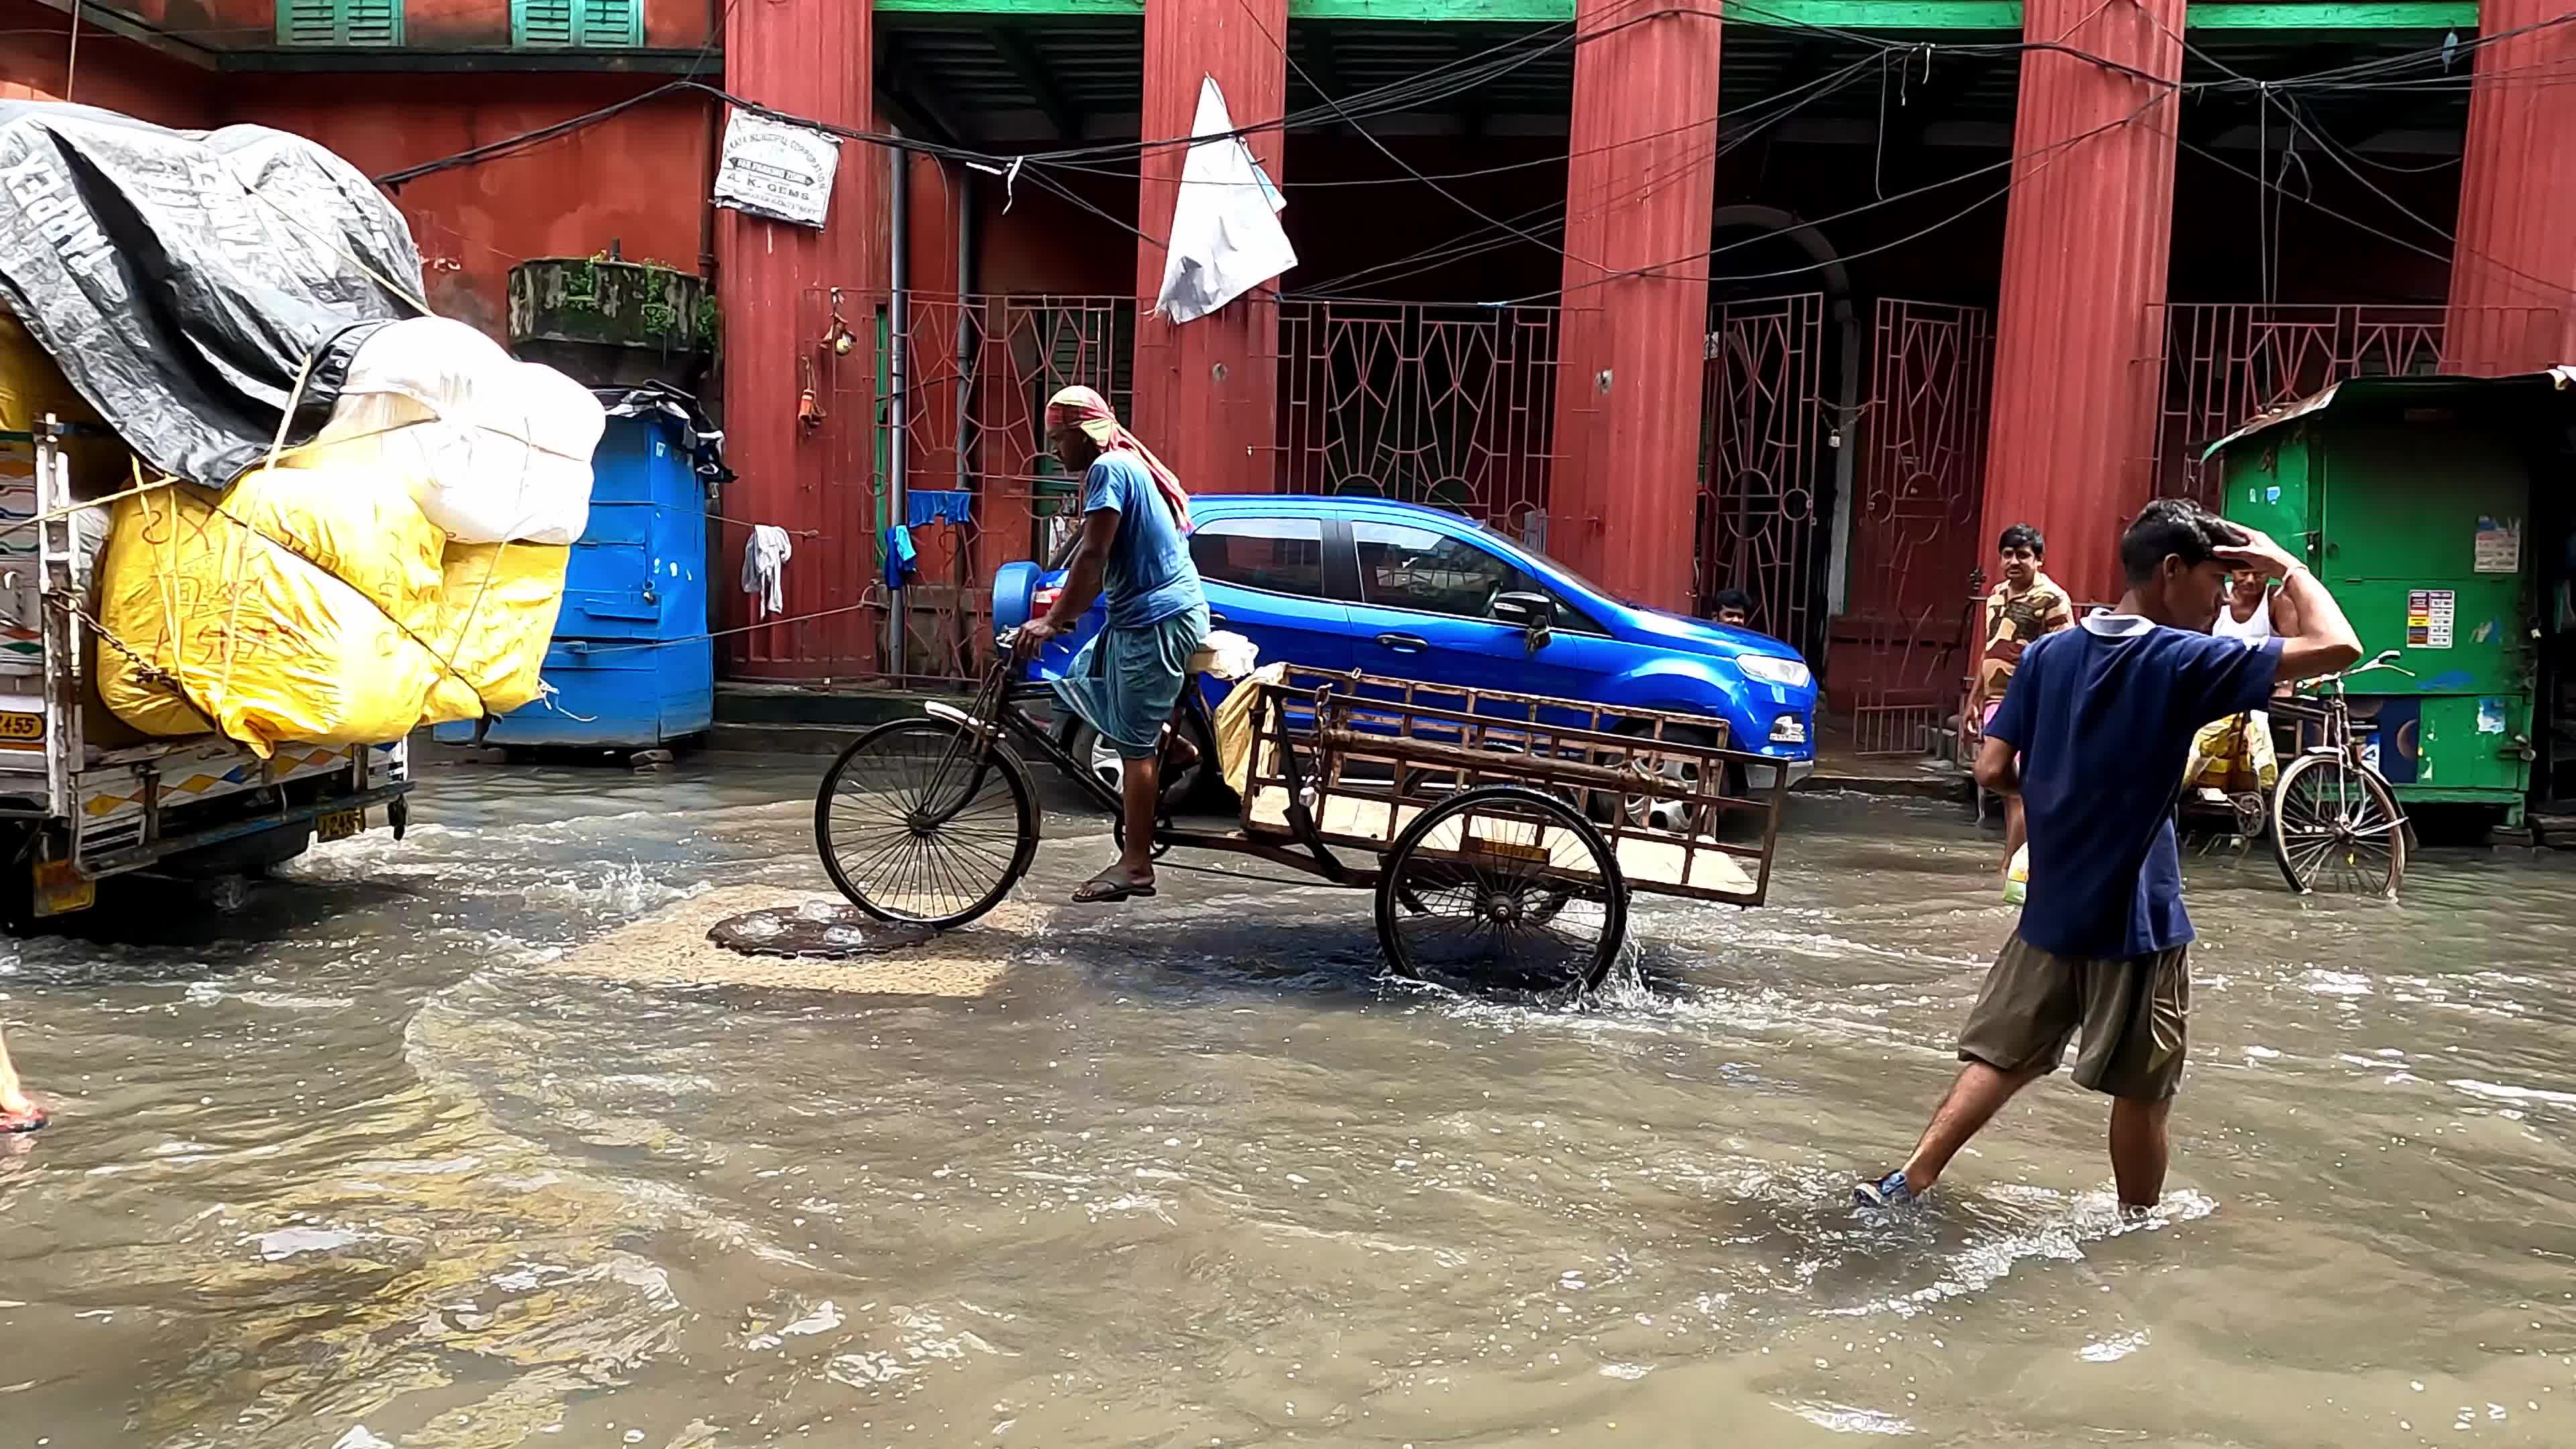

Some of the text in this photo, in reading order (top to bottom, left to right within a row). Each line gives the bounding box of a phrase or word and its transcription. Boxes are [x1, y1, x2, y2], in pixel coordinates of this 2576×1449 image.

[1, 149, 116, 276] TARPEX
[747, 178, 761, 189] K.
[767, 184, 809, 201] GEMS
